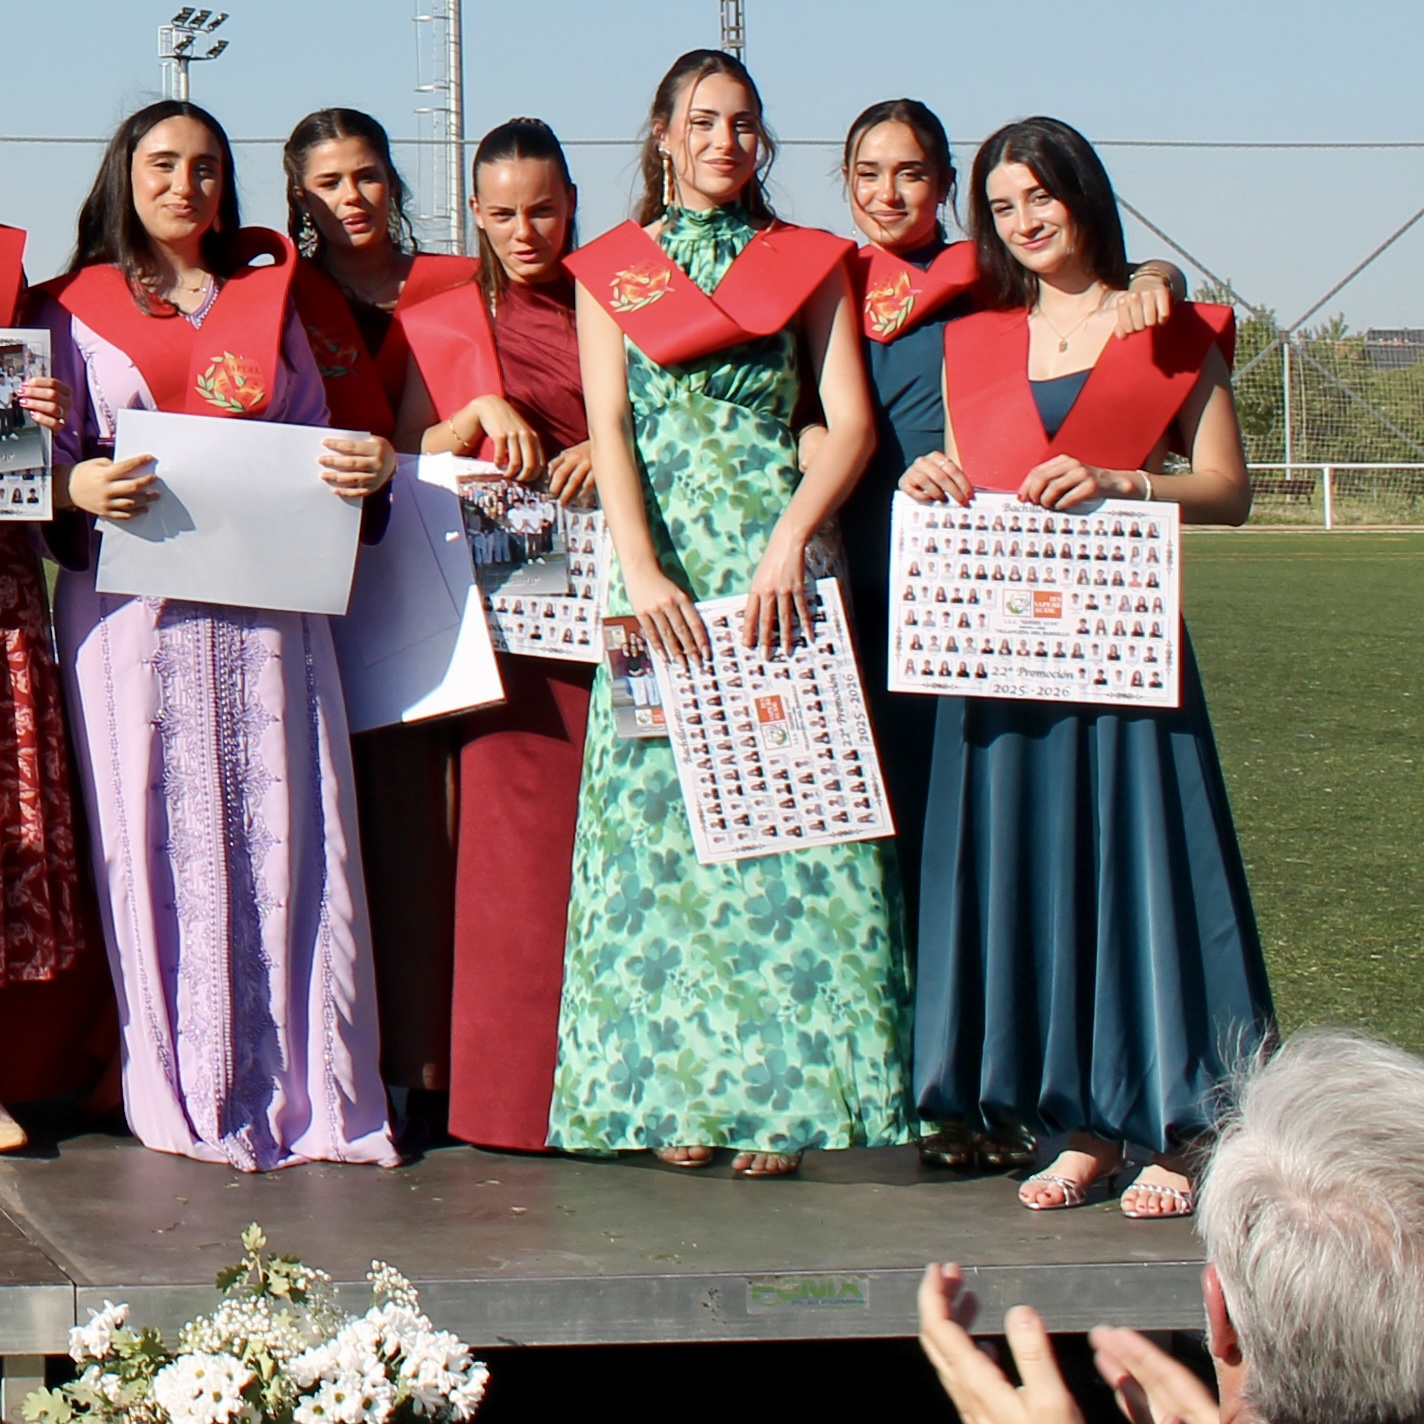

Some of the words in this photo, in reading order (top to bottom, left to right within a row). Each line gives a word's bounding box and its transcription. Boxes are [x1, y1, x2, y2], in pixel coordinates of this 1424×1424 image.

[1016, 667, 1074, 680] Promoción
[993, 684, 1026, 697] 2025
[854, 713, 870, 743] 2025
